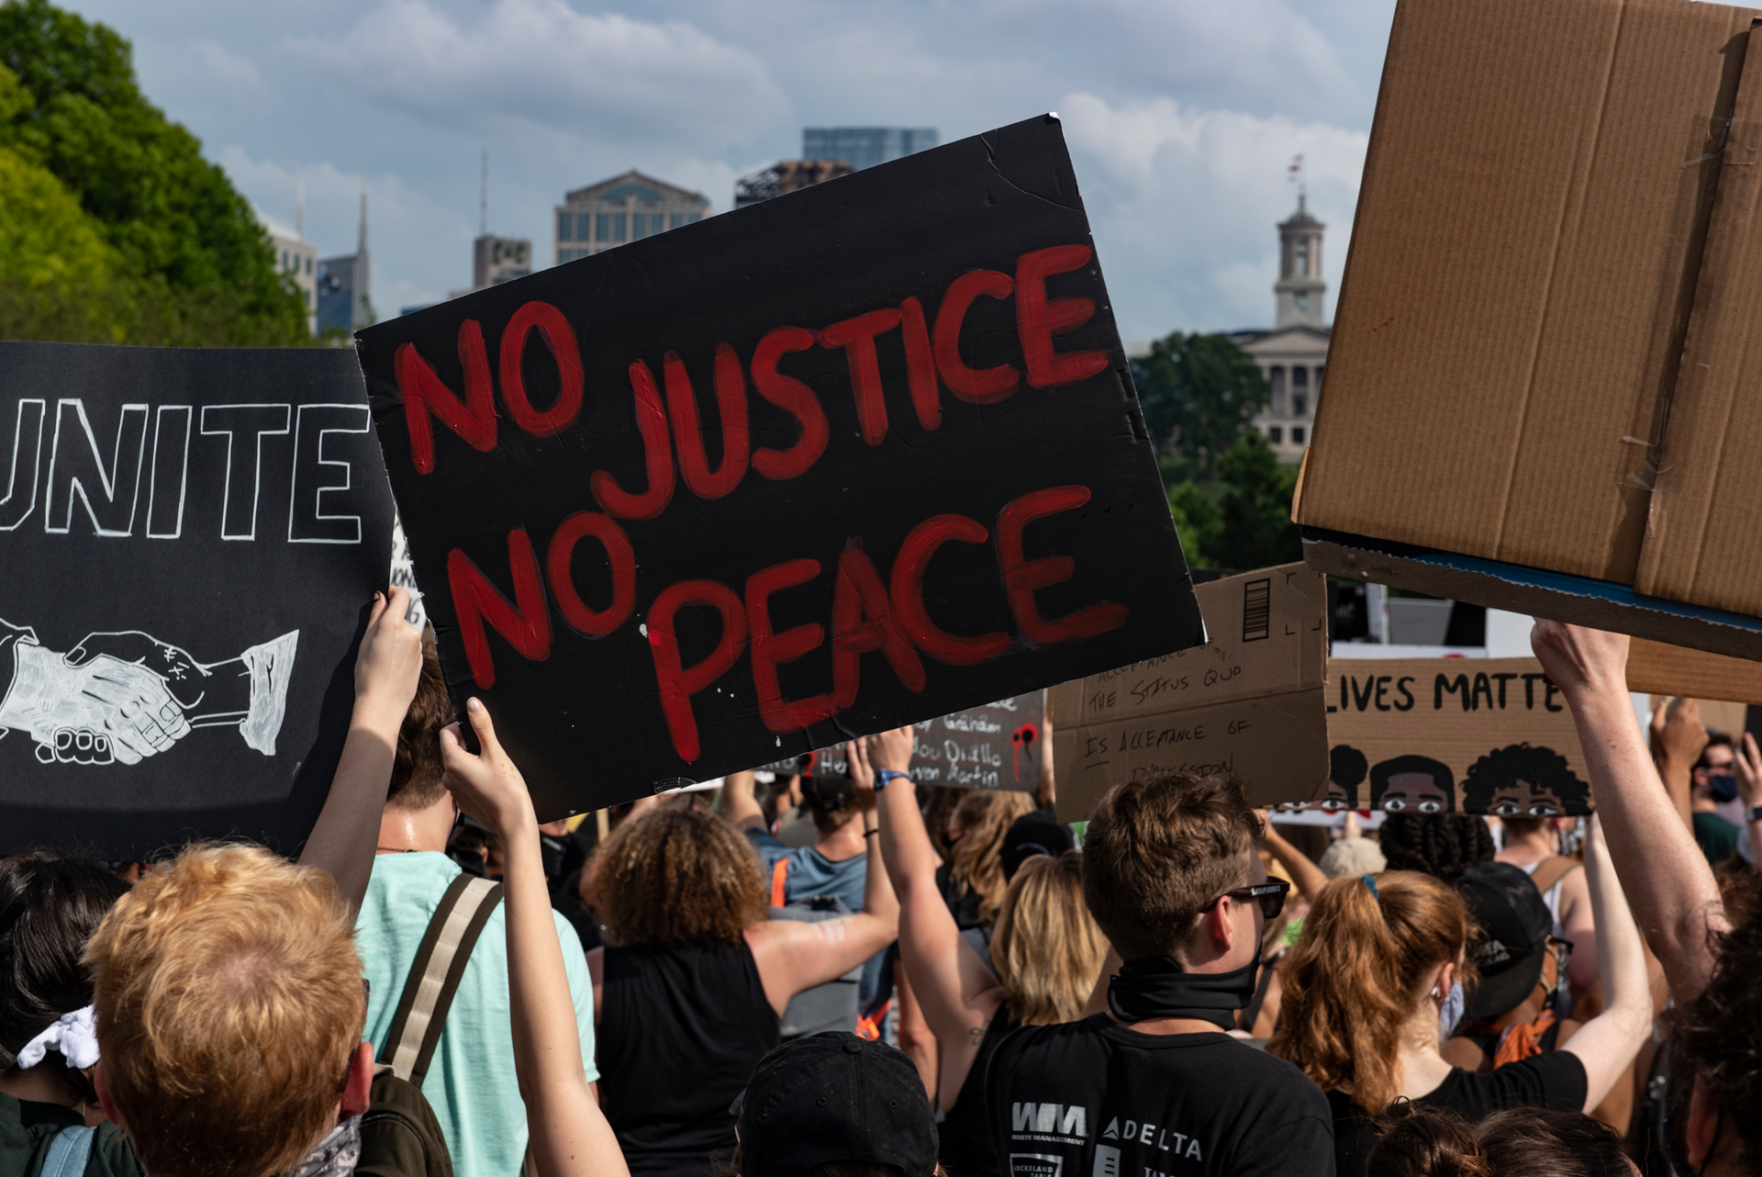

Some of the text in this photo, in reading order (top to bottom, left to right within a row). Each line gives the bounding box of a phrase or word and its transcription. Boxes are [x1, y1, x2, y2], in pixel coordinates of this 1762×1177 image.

[394, 243, 1109, 519] NO JUSTICE
[446, 484, 1128, 764] NO PEACE
[1089, 665, 1242, 713] THE STATUS QUO
[1327, 672, 1565, 712] IVES MATTE
[1084, 736, 1108, 758] IS
[1118, 725, 1207, 753] ACCEPTANCE
[1033, 1134, 1086, 1146] MANAGEMENT
[1122, 1119, 1203, 1162] DELTA
[1013, 1164, 1054, 1173] LOCKELAND
